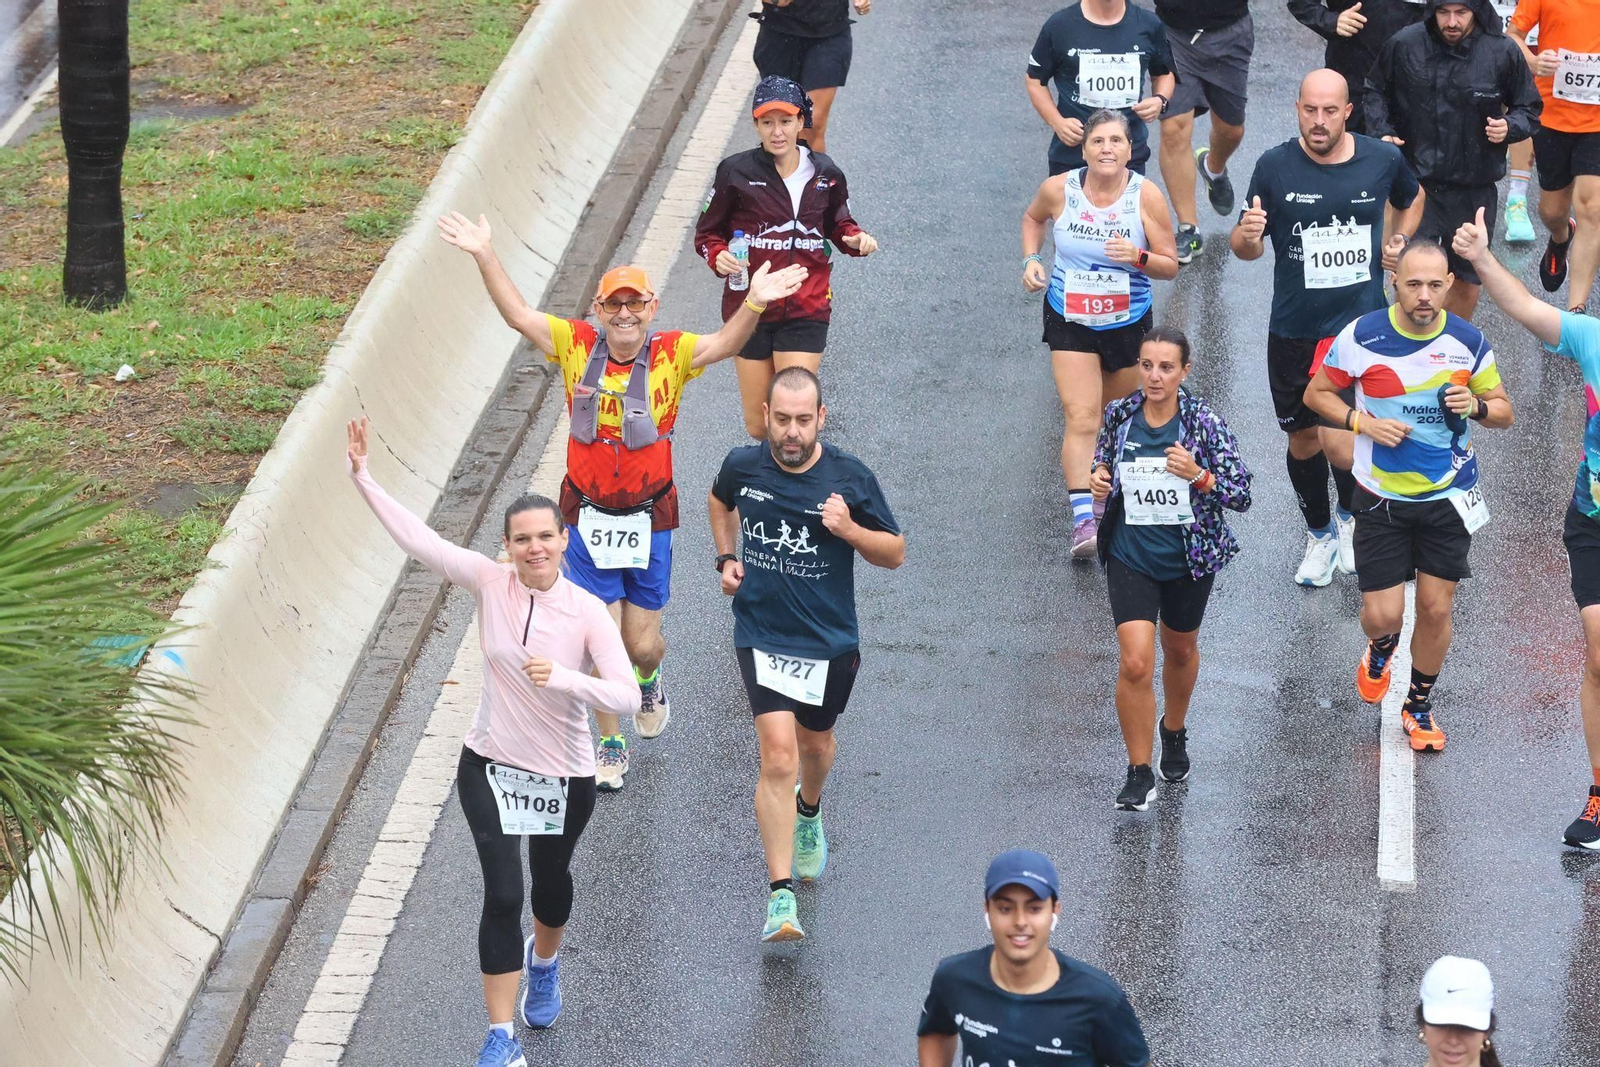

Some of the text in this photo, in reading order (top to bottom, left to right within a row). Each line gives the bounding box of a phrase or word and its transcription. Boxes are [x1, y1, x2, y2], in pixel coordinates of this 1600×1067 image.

[1086, 76, 1134, 92] 10001
[1288, 245, 1303, 254] CAR
[1288, 252, 1304, 262] URB
[1311, 248, 1367, 269] 10008
[1081, 297, 1116, 314] 193
[1402, 405, 1443, 415] Málag
[1416, 416, 1444, 424] 202
[1133, 489, 1179, 506] 1403
[590, 528, 640, 549] 5176
[744, 547, 778, 563] CARRERA
[744, 555, 778, 571] URBANA
[785, 557, 819, 569] Ciudad
[767, 653, 816, 681] 3727
[501, 790, 561, 815] 11108
